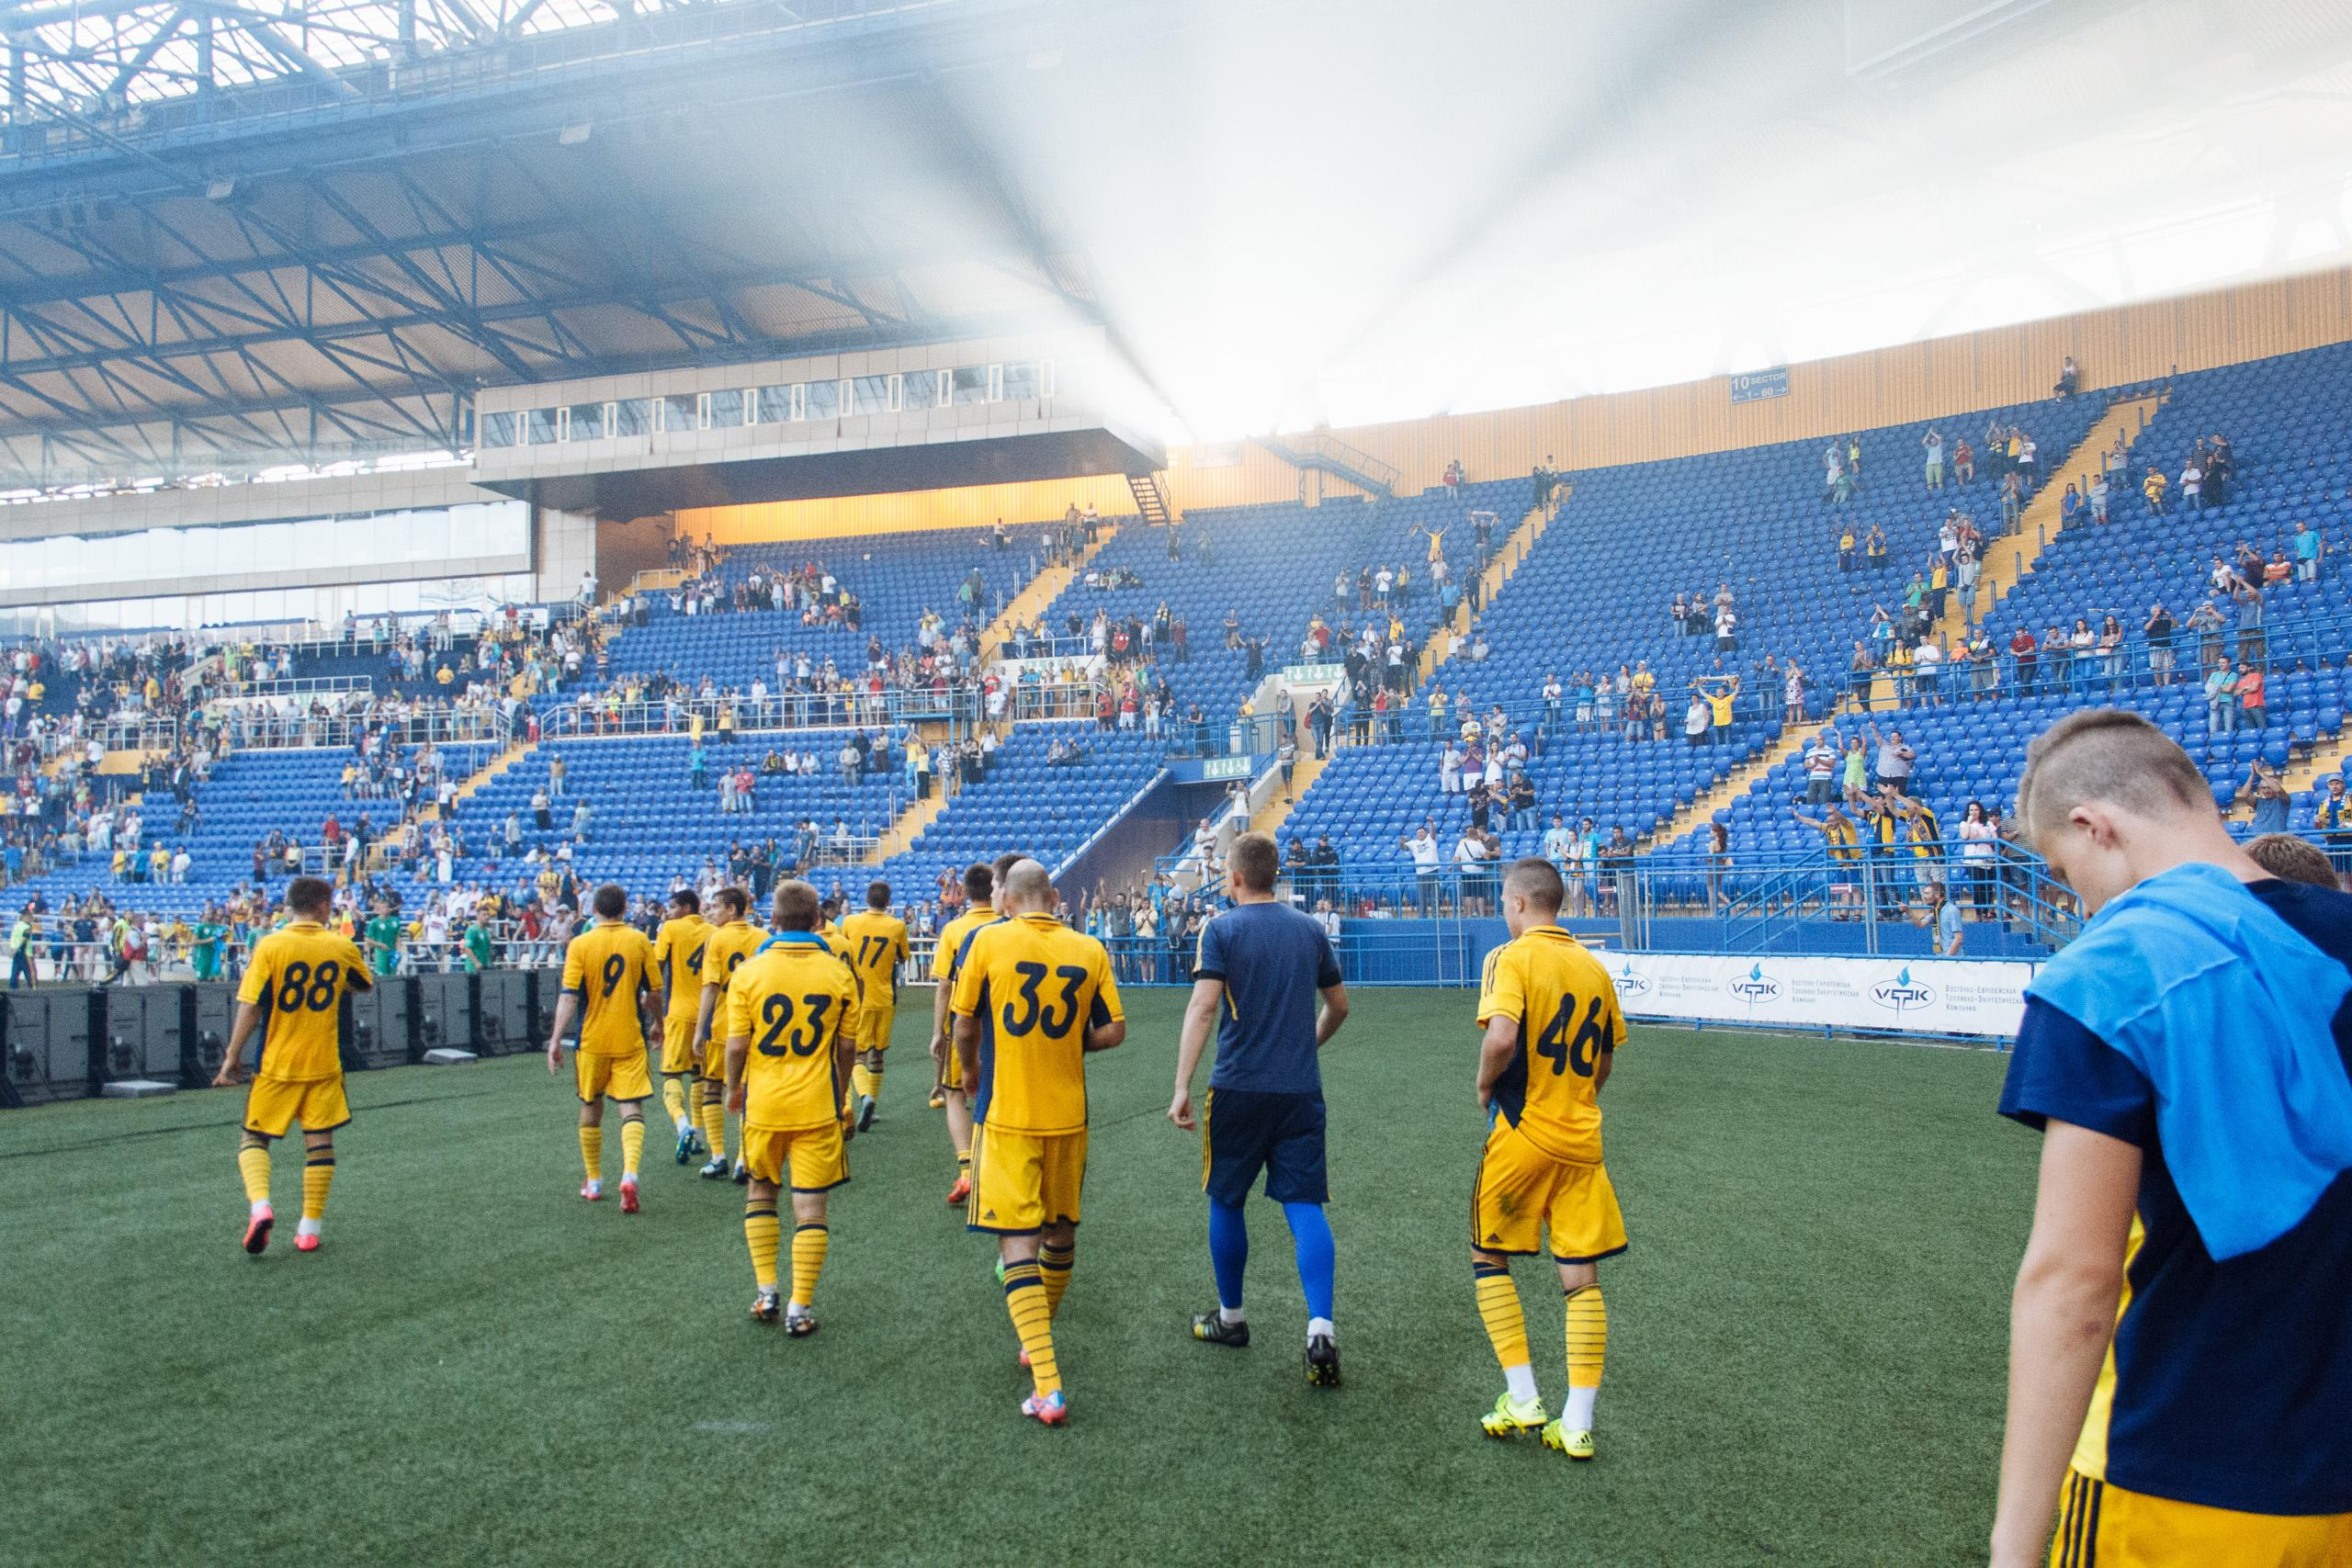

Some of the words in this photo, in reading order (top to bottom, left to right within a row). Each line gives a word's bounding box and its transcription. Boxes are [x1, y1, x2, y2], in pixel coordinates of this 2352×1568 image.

[1732, 376, 1750, 390] 10
[1750, 372, 1787, 385] SECTOR
[1747, 390, 1752, 399] 1
[1761, 387, 1773, 397] 60
[602, 953, 626, 998] 9
[857, 935, 889, 968] 17
[277, 960, 340, 1014] 88
[1002, 961, 1089, 1040] 33
[757, 993, 832, 1057] 23
[1535, 992, 1602, 1077] 46
